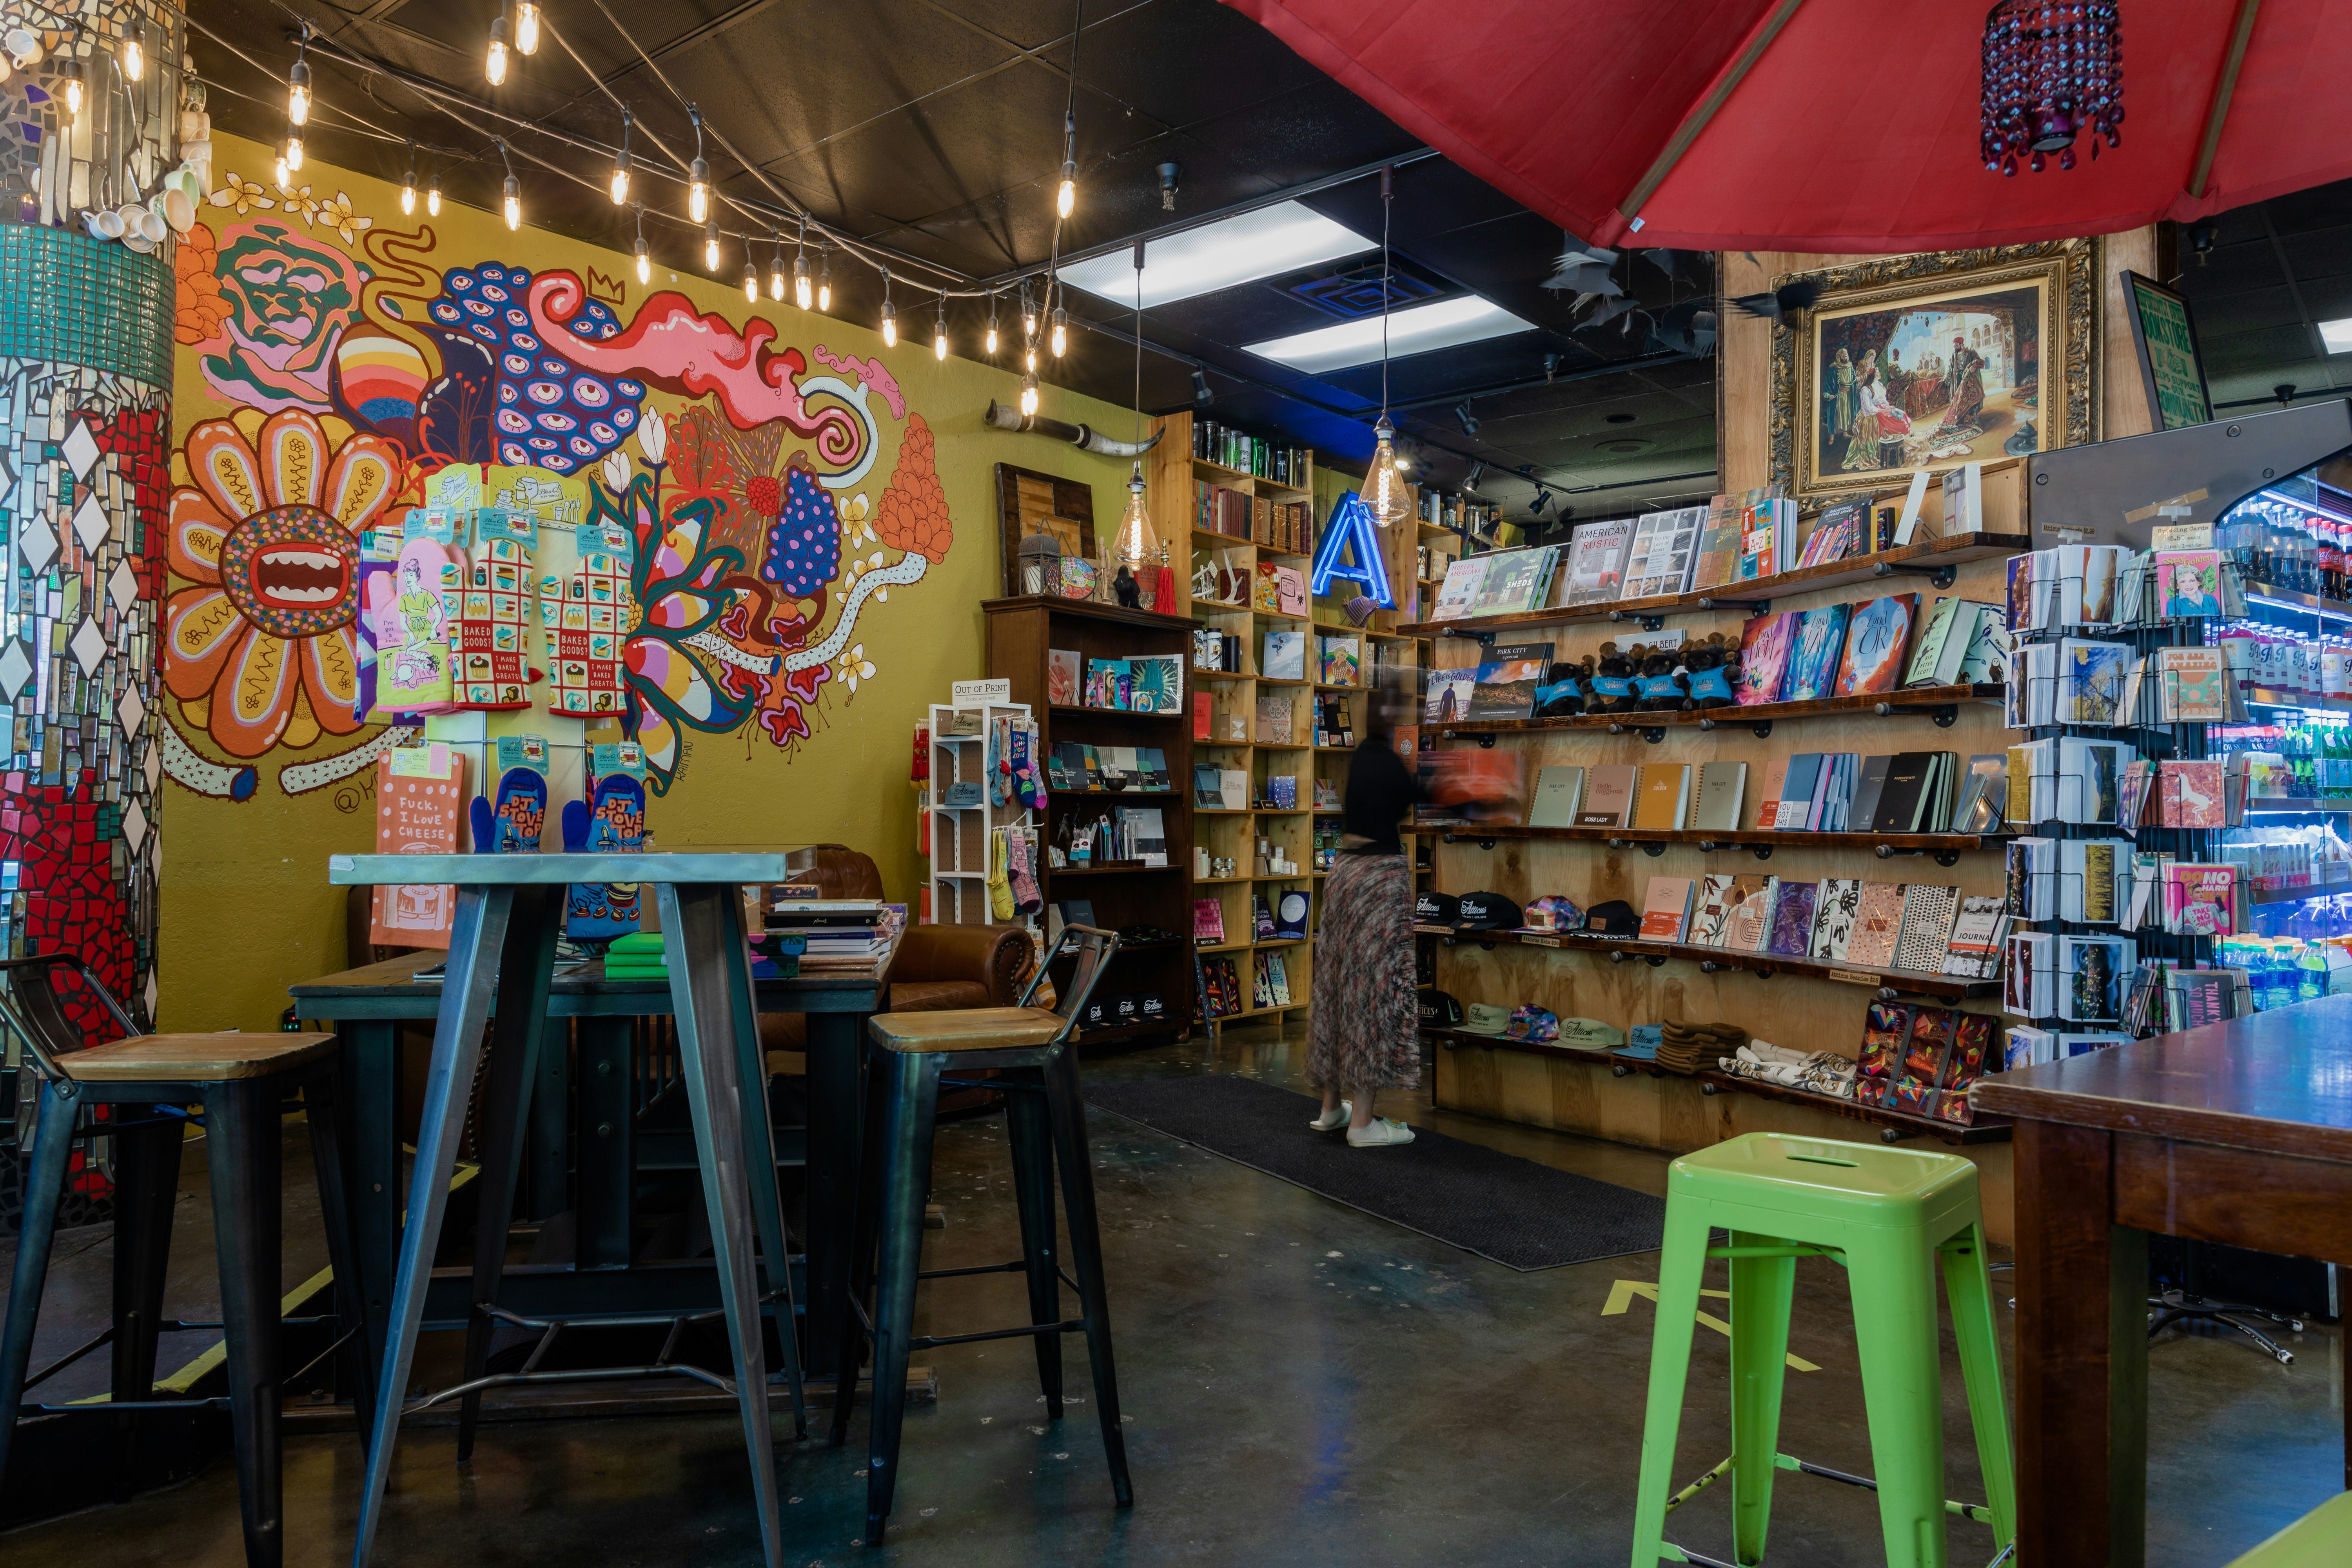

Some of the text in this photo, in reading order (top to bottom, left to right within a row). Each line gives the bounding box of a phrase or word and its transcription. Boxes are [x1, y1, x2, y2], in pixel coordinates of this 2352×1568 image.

[2171, 375, 2201, 393] SUPPORT
[2171, 384, 2185, 397] OUR
[1829, 505, 1852, 514] BIBLIOPHILE
[1578, 526, 1628, 540] AMERICAN
[1312, 490, 1398, 610] A
[1583, 538, 1619, 550] RUSTIC
[1452, 563, 1475, 572] MODERN
[2162, 553, 2214, 568] Stay Golden
[1449, 569, 1481, 577] AMERICANA
[1506, 579, 1533, 589] SHEDS
[1811, 612, 1829, 628] Land
[1866, 610, 1887, 628] Land
[464, 626, 491, 636] BAKED
[1756, 627, 1773, 641] Land
[464, 637, 492, 648] GOODS?
[561, 635, 588, 645] BAKED
[1648, 639, 1677, 649] GILBERT
[1858, 626, 1887, 655] OR
[561, 645, 588, 655] GOODS?
[1748, 635, 1776, 663] NOW
[2167, 661, 2218, 671] AMAZING
[495, 672, 521, 680] GREATS!
[1431, 674, 1445, 686] LIFE
[1450, 672, 1476, 682] GOLDEN
[953, 716, 973, 728] Atticus
[954, 784, 976, 797] Atticus
[1596, 788, 1623, 796] Gorgeous
[399, 797, 438, 811] FUCK,
[414, 814, 442, 825] LOVE
[499, 803, 543, 828] STOVE
[595, 806, 643, 828] STOVE
[399, 826, 445, 840] CHEESE
[511, 821, 542, 839] TOP
[609, 823, 642, 840] TOP
[2180, 871, 2231, 885] DO NO
[2202, 891, 2229, 902] BUT
[1416, 897, 1440, 912] Atticus
[1461, 900, 1486, 915] Atticus
[2192, 906, 2210, 916] TAKE
[2196, 913, 2210, 922] NO
[1849, 974, 1869, 982] Beanies
[2204, 982, 2221, 1016] THANK
[1470, 1007, 1490, 1022] Atticus
[1566, 1021, 1594, 1037] Atticus
[1631, 1027, 1654, 1044] Atticus
[1915, 1051, 1926, 1060] GOOD
[1909, 1058, 1933, 1072] VIBRATIONS
